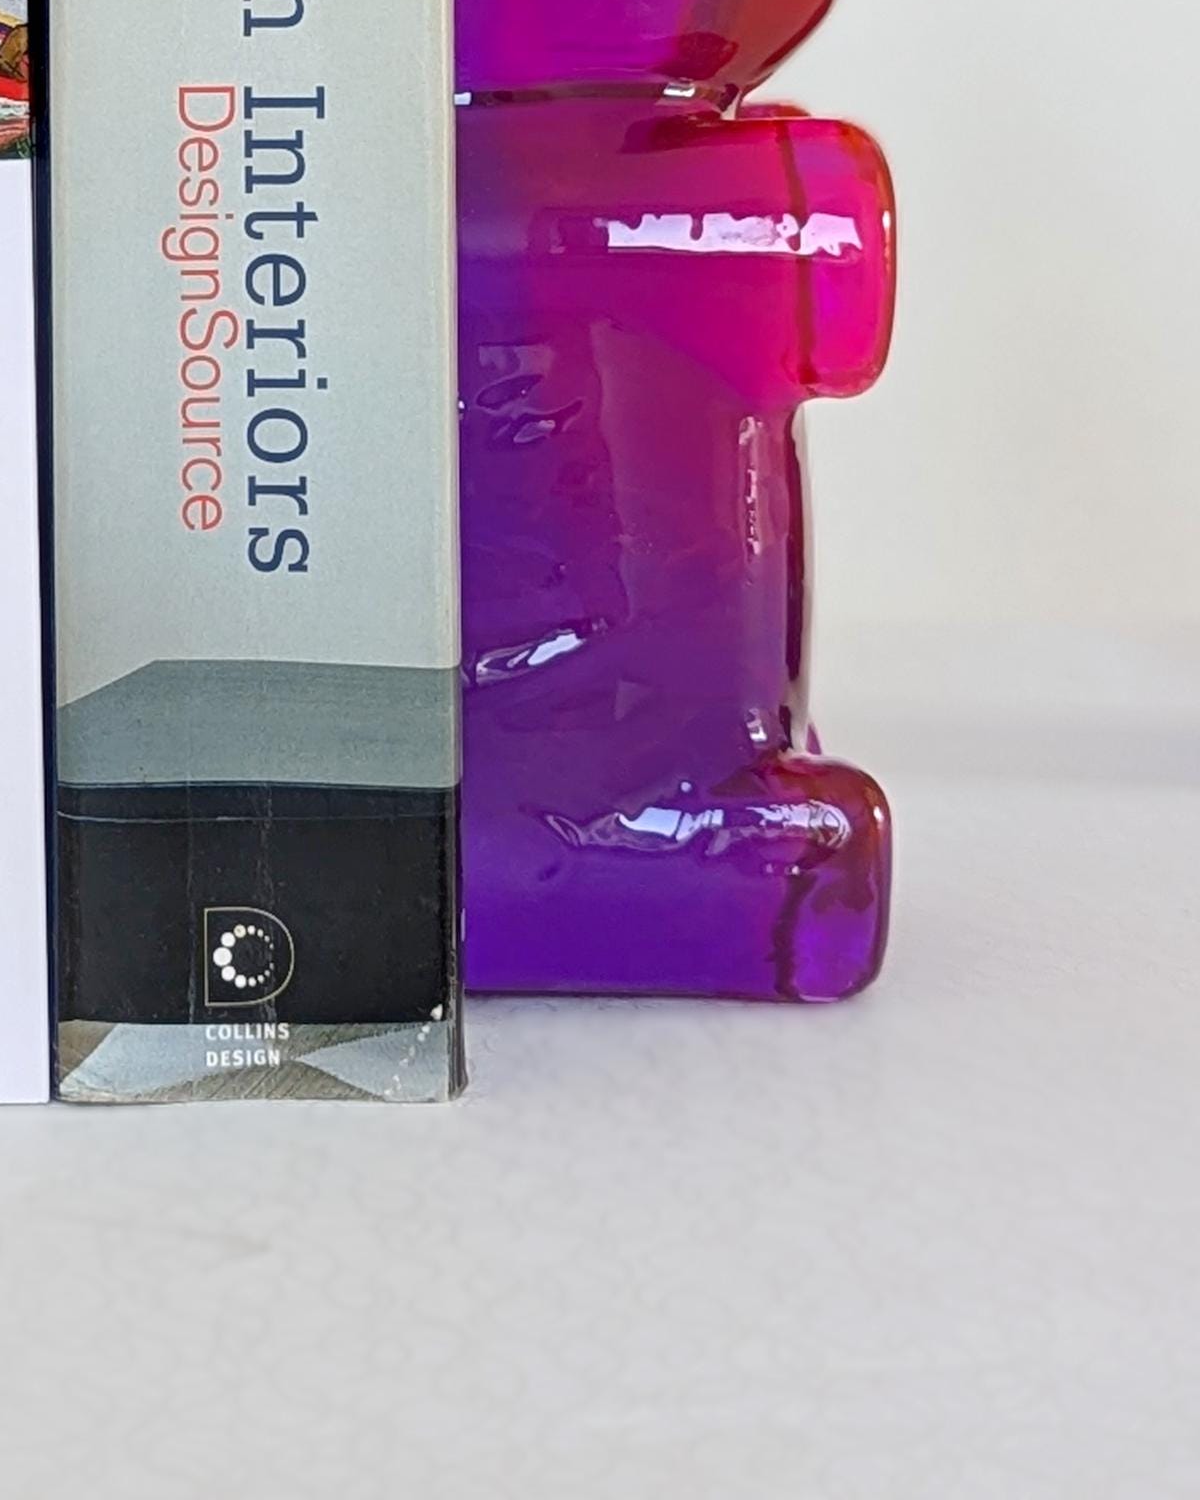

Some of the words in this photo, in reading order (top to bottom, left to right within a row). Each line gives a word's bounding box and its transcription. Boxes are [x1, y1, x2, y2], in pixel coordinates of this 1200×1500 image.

[160, 84, 240, 533] DesignSource
[242, 84, 329, 576] Interiors
[204, 1021, 290, 1041] COLLINS
[204, 1049, 282, 1068] DESIGN
